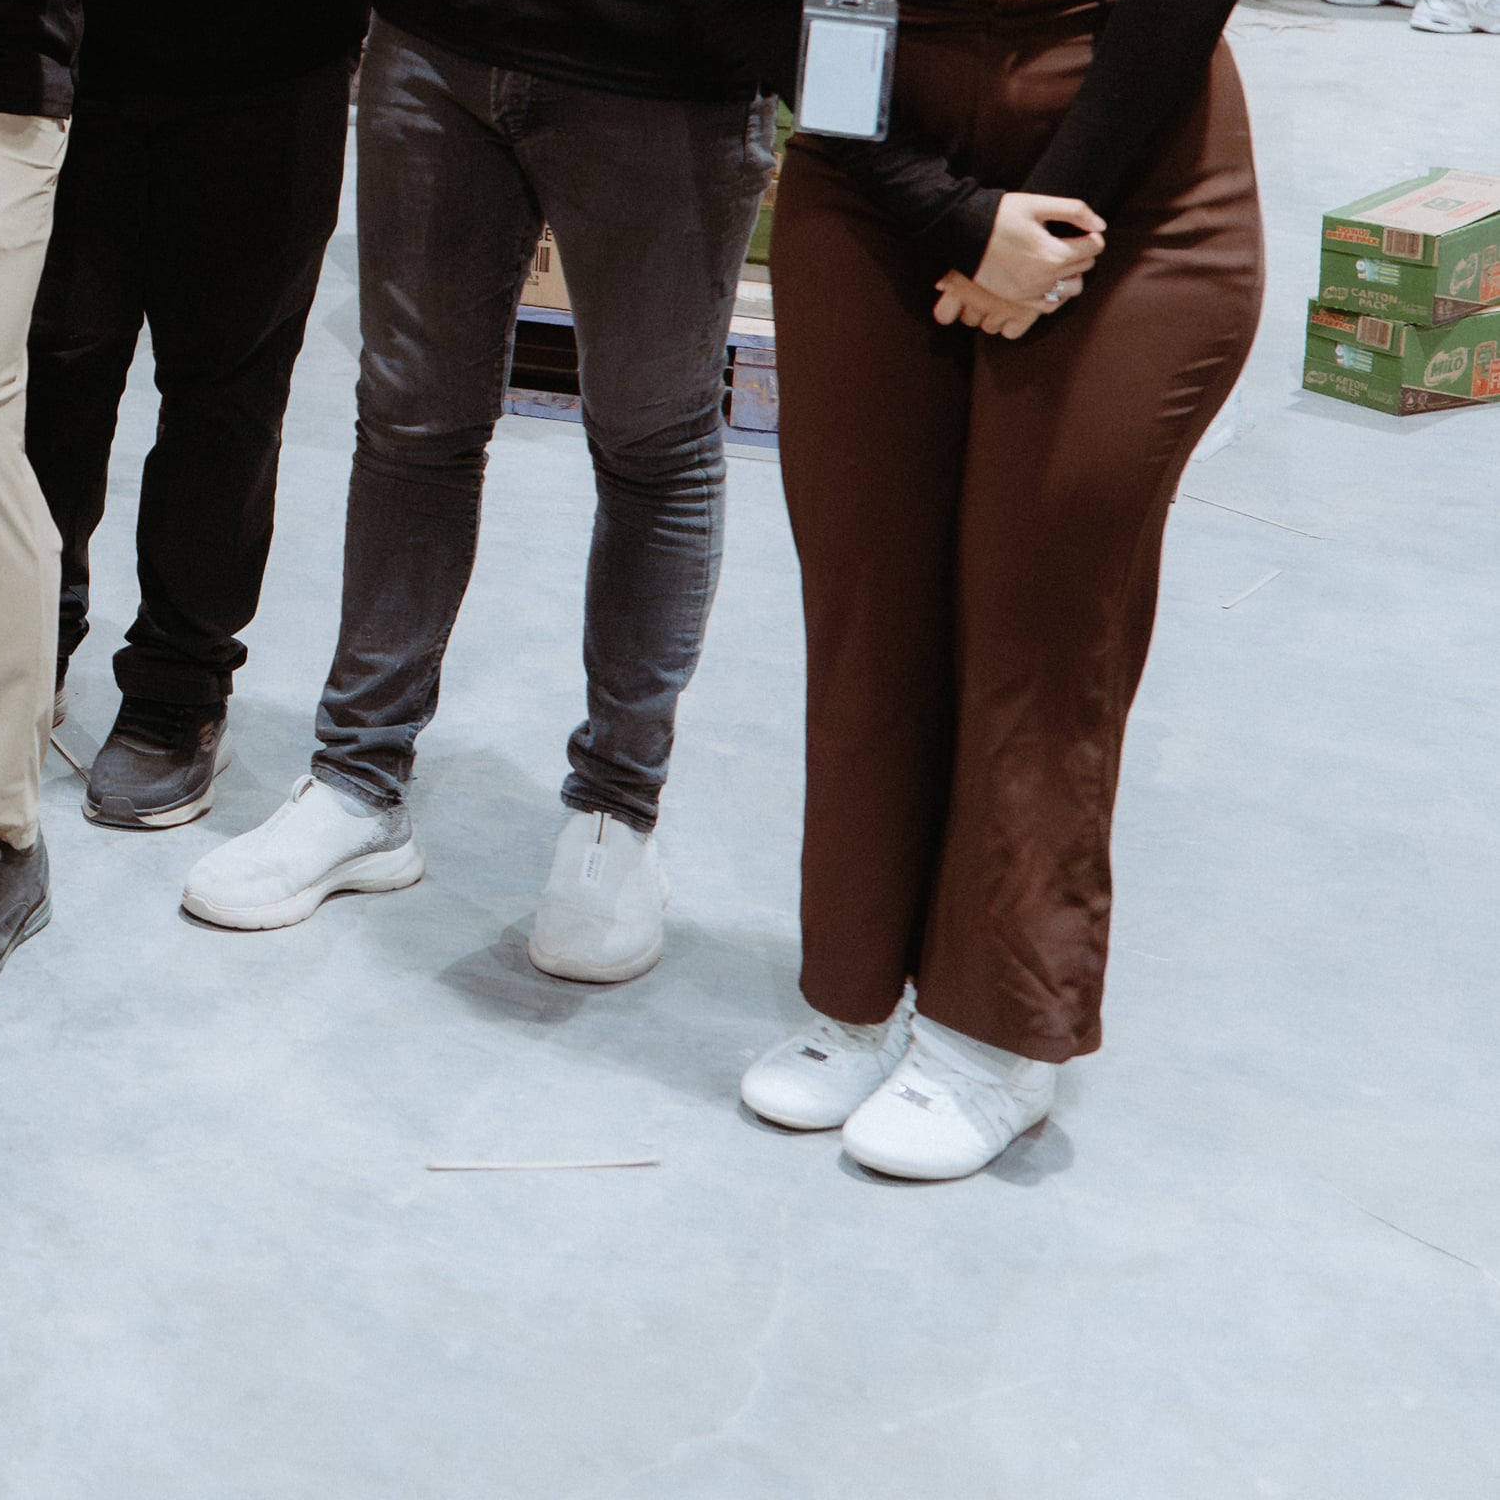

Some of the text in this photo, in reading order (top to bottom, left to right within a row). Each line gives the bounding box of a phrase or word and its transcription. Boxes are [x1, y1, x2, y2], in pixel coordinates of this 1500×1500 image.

[1351, 288, 1398, 304] CARTON
[1358, 298, 1388, 311] PACK
[1329, 374, 1369, 391] CARTON
